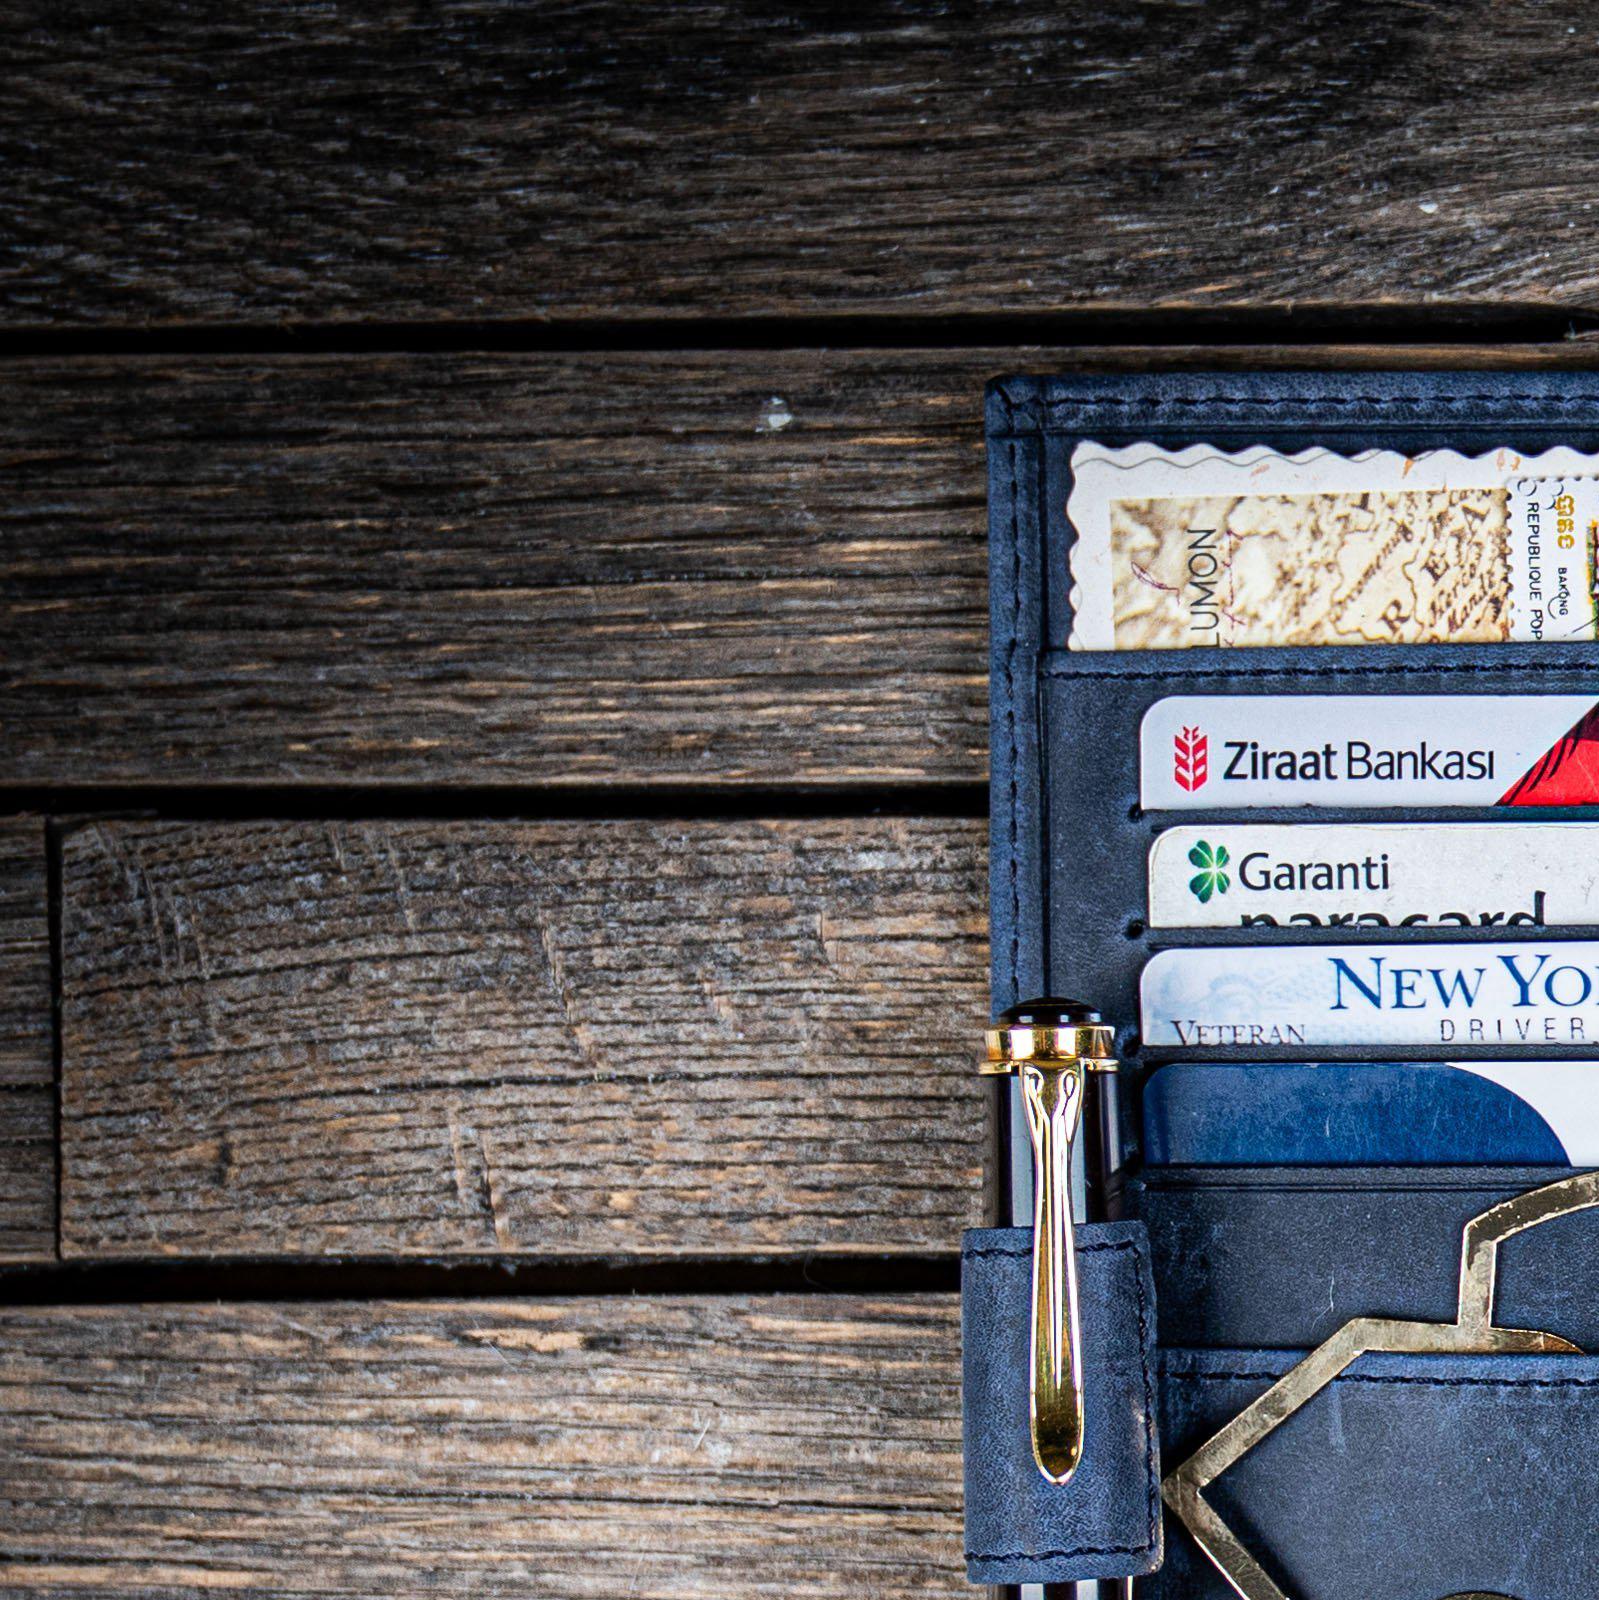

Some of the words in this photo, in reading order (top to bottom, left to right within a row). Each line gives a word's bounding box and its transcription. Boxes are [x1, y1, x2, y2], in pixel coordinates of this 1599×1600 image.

[1526, 501, 1543, 601] REPUBLIQUE
[1557, 566, 1570, 616] BAKONG
[1223, 741, 1339, 781] Ziraat
[1347, 742, 1496, 781] Bankası
[1238, 853, 1391, 891] Garanti
[1328, 956, 1487, 1010] NEW
[1169, 1018, 1305, 1046] VETERAN
[1440, 1017, 1586, 1042] DRIVER
